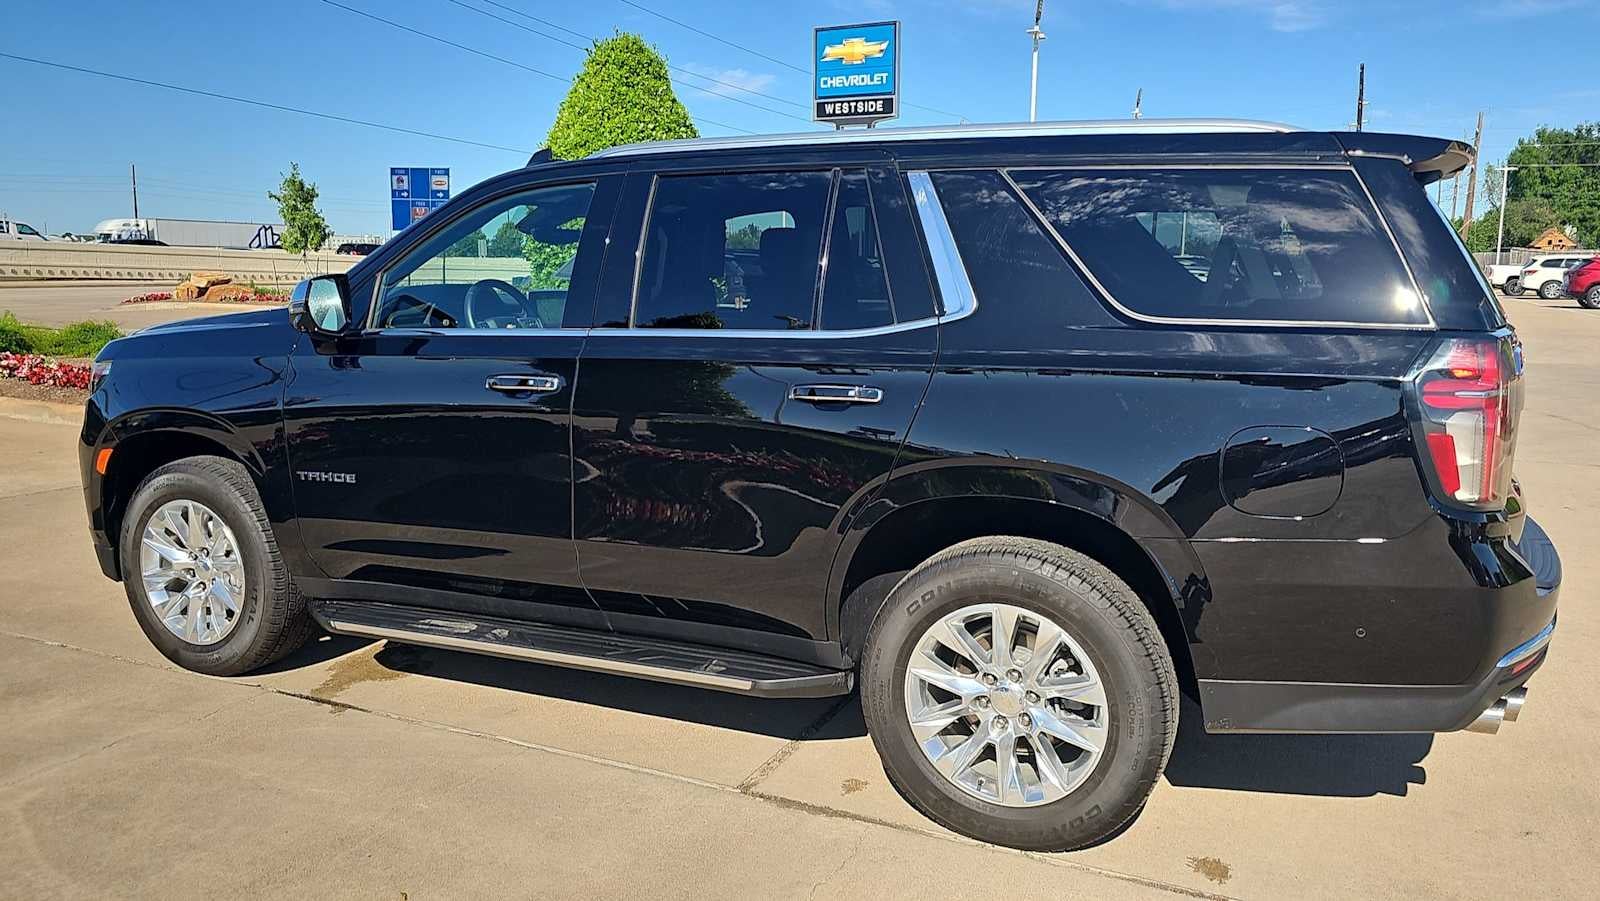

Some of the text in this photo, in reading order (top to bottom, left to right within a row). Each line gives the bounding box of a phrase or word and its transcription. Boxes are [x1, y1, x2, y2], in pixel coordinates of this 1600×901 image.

[820, 73, 888, 89] CHEVROLET
[825, 100, 884, 115] WESTSIDE
[296, 471, 356, 483] TAHOE
